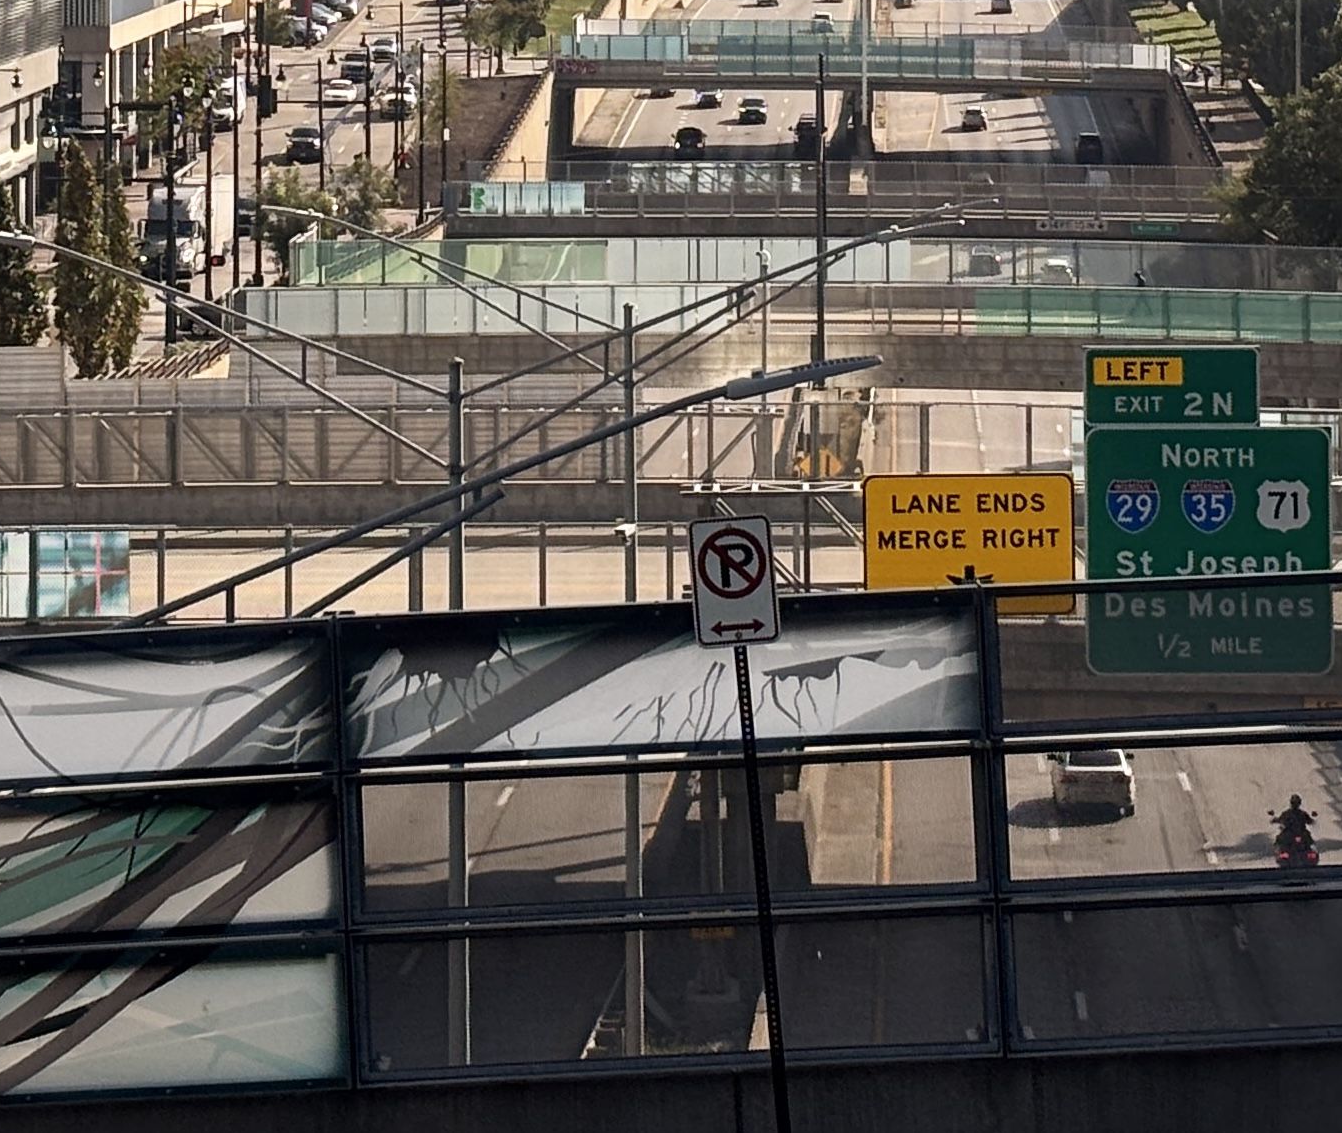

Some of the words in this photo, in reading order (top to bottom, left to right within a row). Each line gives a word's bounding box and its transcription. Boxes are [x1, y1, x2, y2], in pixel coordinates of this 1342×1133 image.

[1106, 361, 1170, 381] LEFT
[1114, 395, 1163, 413] EXIT
[1161, 443, 1255, 467] NORTH
[891, 494, 961, 514] LANE
[976, 493, 1045, 513] ENDS
[1116, 494, 1153, 522] 29
[1191, 494, 1226, 522] 35
[1268, 491, 1300, 519] 71
[878, 530, 967, 549] MERGE
[982, 528, 1060, 548] RIGHT
[1116, 550, 1153, 576] St
[1176, 550, 1303, 575] Joseph
[1105, 593, 1167, 618] Des
[1189, 591, 1315, 618] Moines
[1211, 637, 1263, 655] MILE
